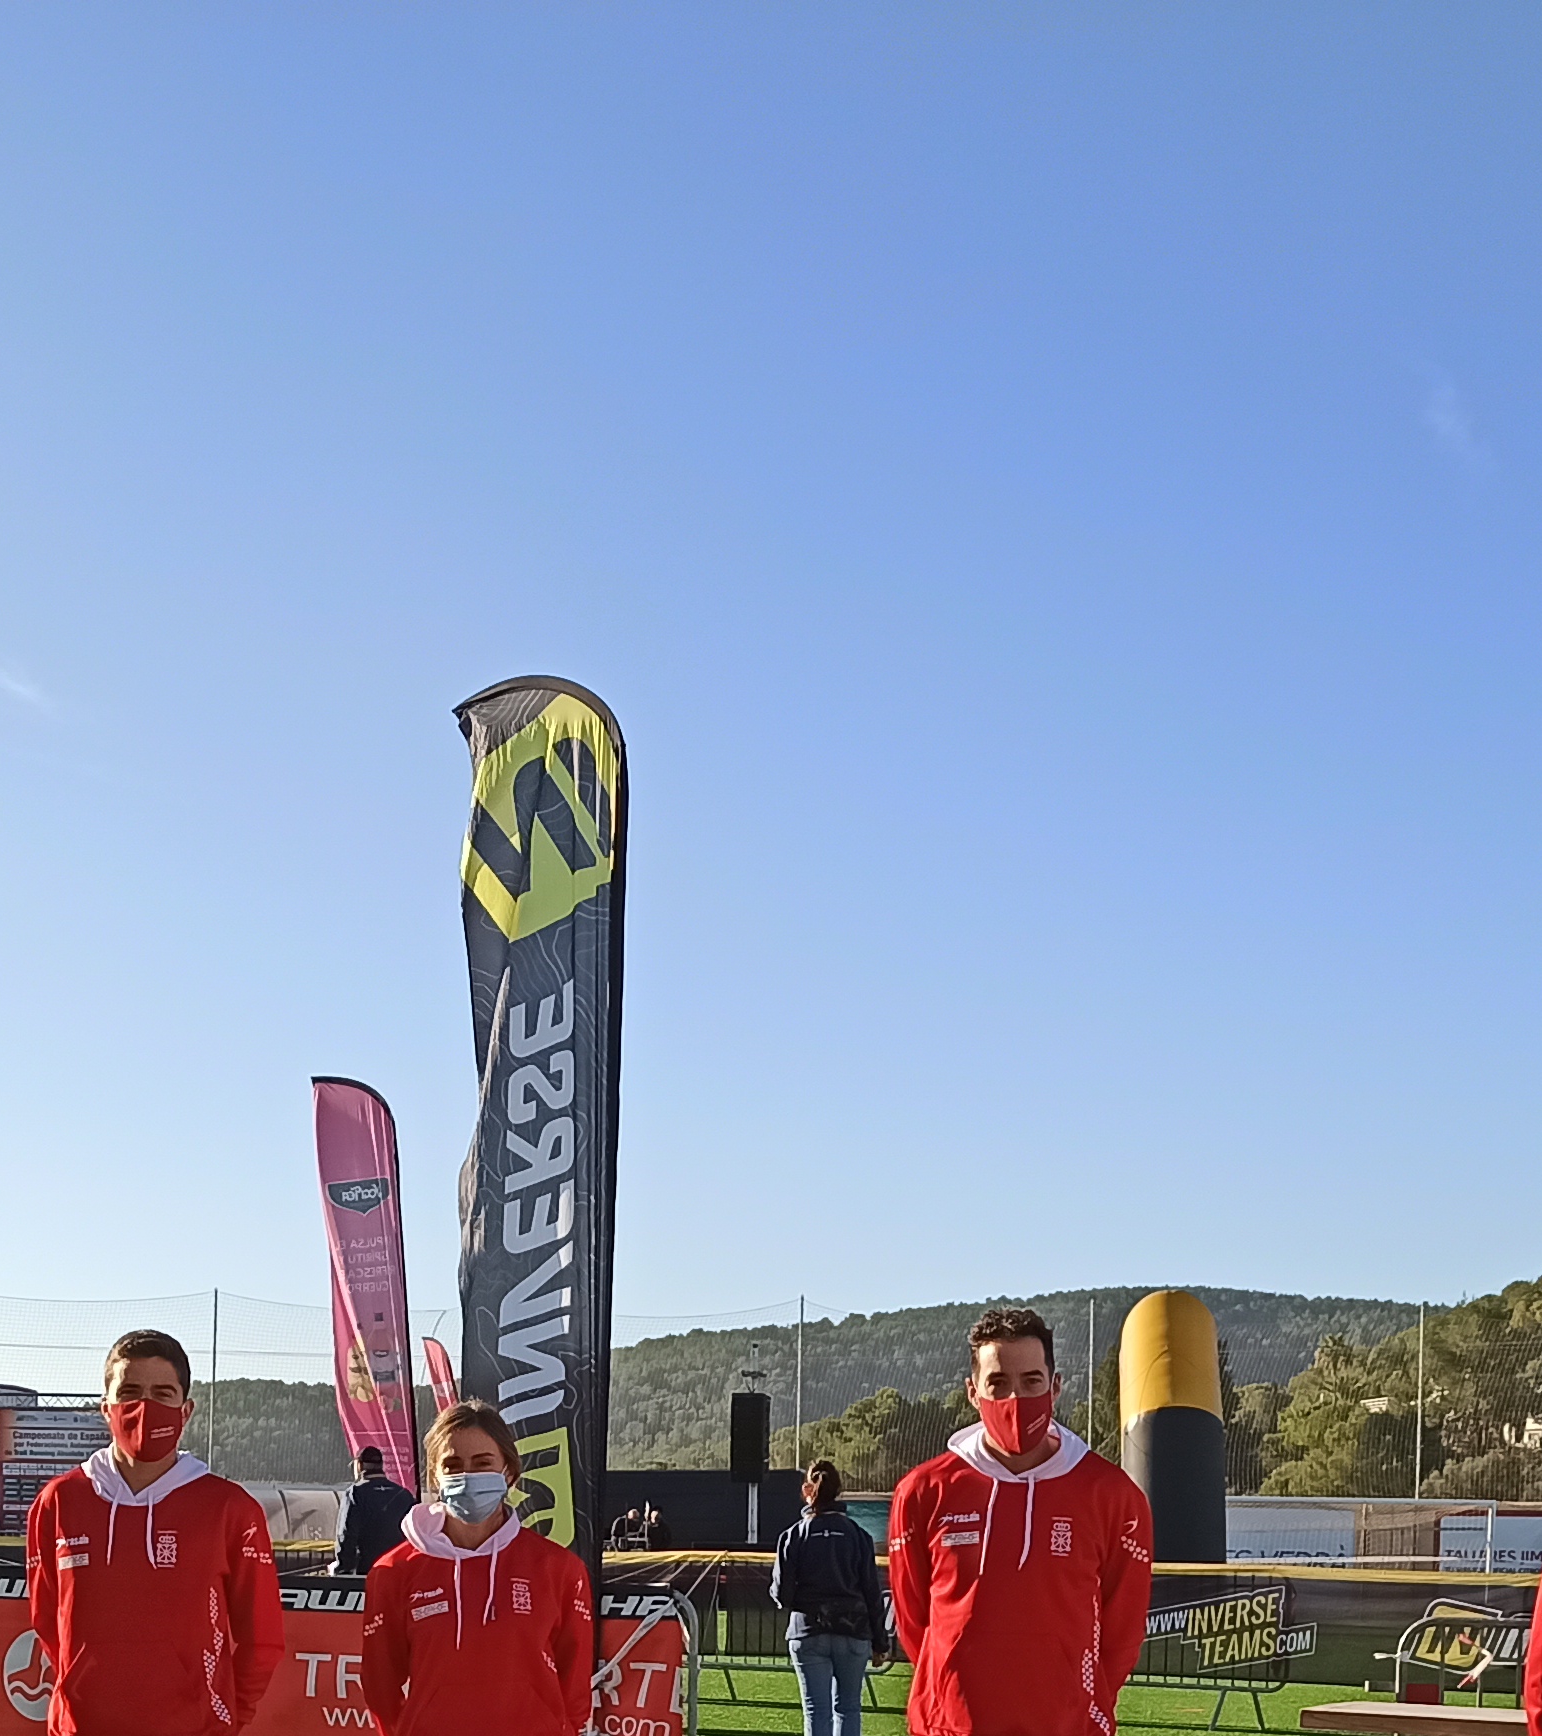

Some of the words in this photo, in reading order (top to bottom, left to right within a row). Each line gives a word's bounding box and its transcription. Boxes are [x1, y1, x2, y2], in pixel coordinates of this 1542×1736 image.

[1186, 1592, 1280, 1637] INVERSE
[1201, 1627, 1277, 1667] TEAMS
[1276, 1630, 1311, 1654] COM
